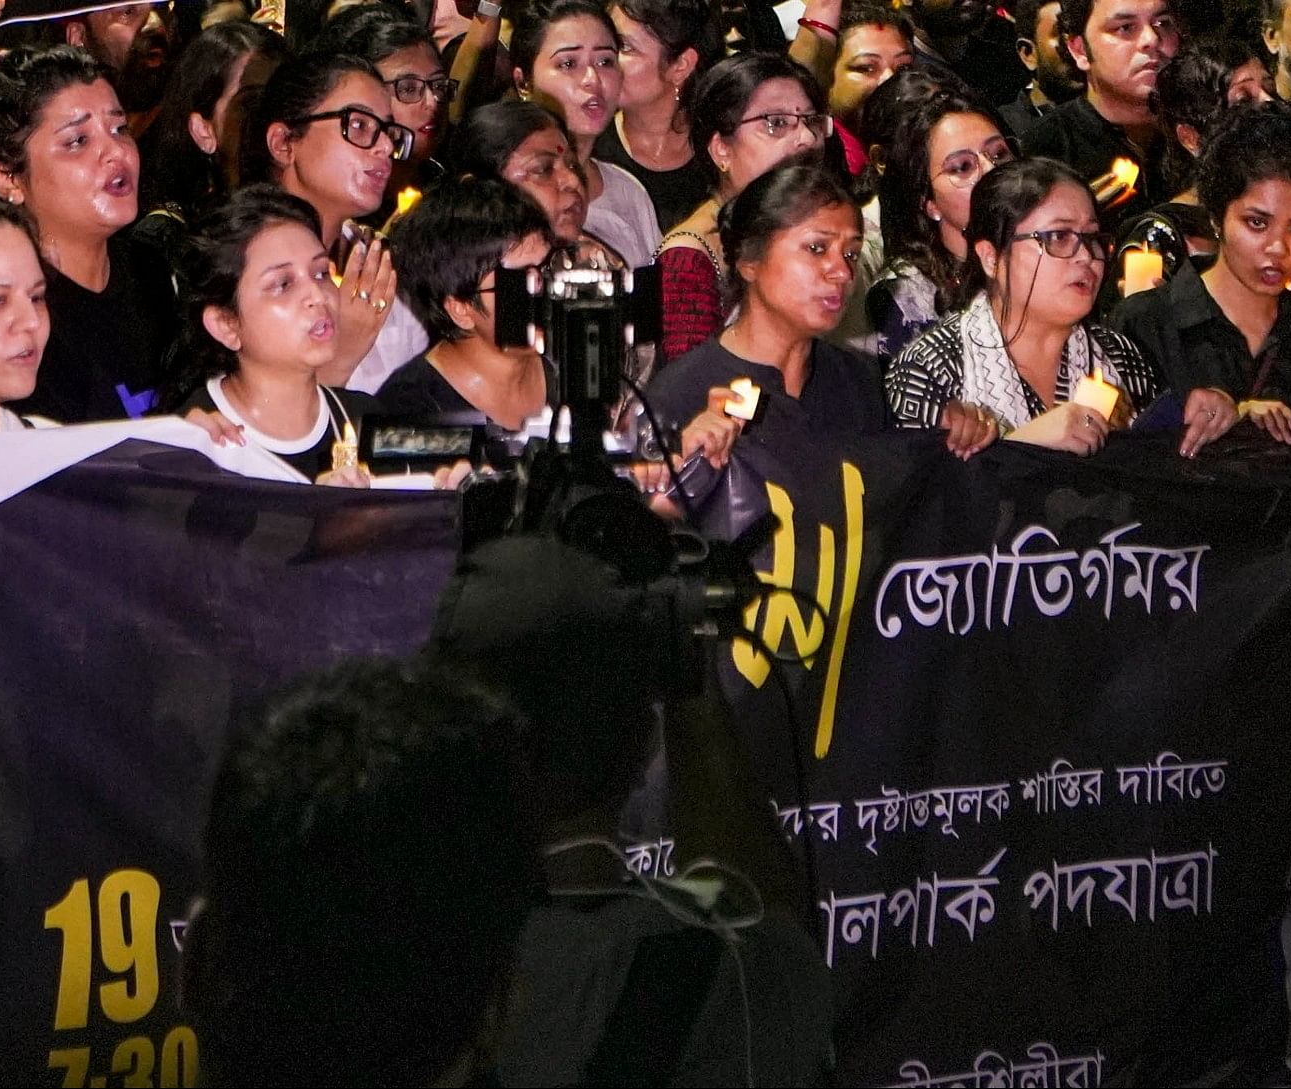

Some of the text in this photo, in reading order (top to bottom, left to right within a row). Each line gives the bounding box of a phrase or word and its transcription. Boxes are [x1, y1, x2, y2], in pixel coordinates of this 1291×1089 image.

[875, 522, 1212, 639] জ্যোতির্গময়
[854, 784, 1010, 856] দৃষ্টান্তমূলক
[1020, 758, 1105, 815] শাস্তির
[1116, 750, 1230, 805] দাবিতে
[44, 869, 161, 1030] 19
[820, 841, 1220, 969] ালপার্ক পদযাত্রা
